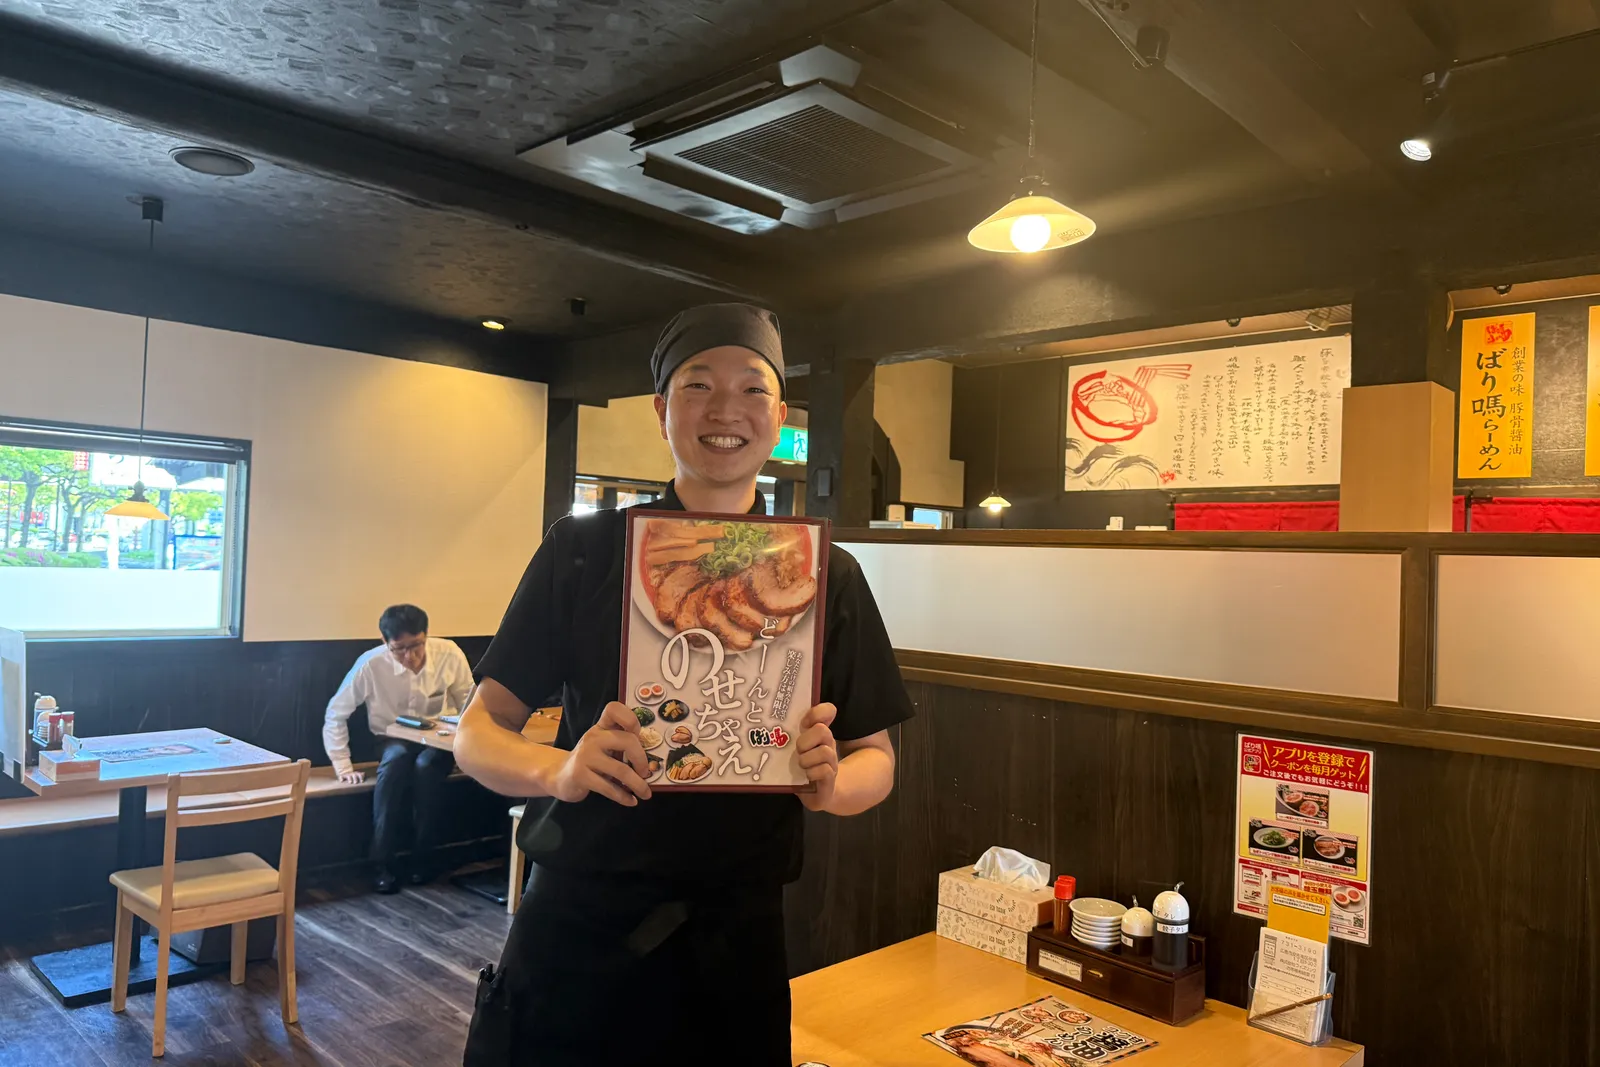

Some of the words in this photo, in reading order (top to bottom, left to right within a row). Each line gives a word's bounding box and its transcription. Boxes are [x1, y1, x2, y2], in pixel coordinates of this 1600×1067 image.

[1509, 346, 1526, 397] 創業の味
[1472, 348, 1507, 471] ばり嗎らーめん
[1508, 402, 1525, 456] 豚骨醤油
[745, 617, 780, 723] どーんと
[771, 649, 797, 719] 楽しみ方は無限大
[1271, 759, 1356, 780] クーポンを毎月ゲット
[1272, 746, 1356, 768] アプリを登録で
[1162, 925, 1185, 933] 餃子タレ
